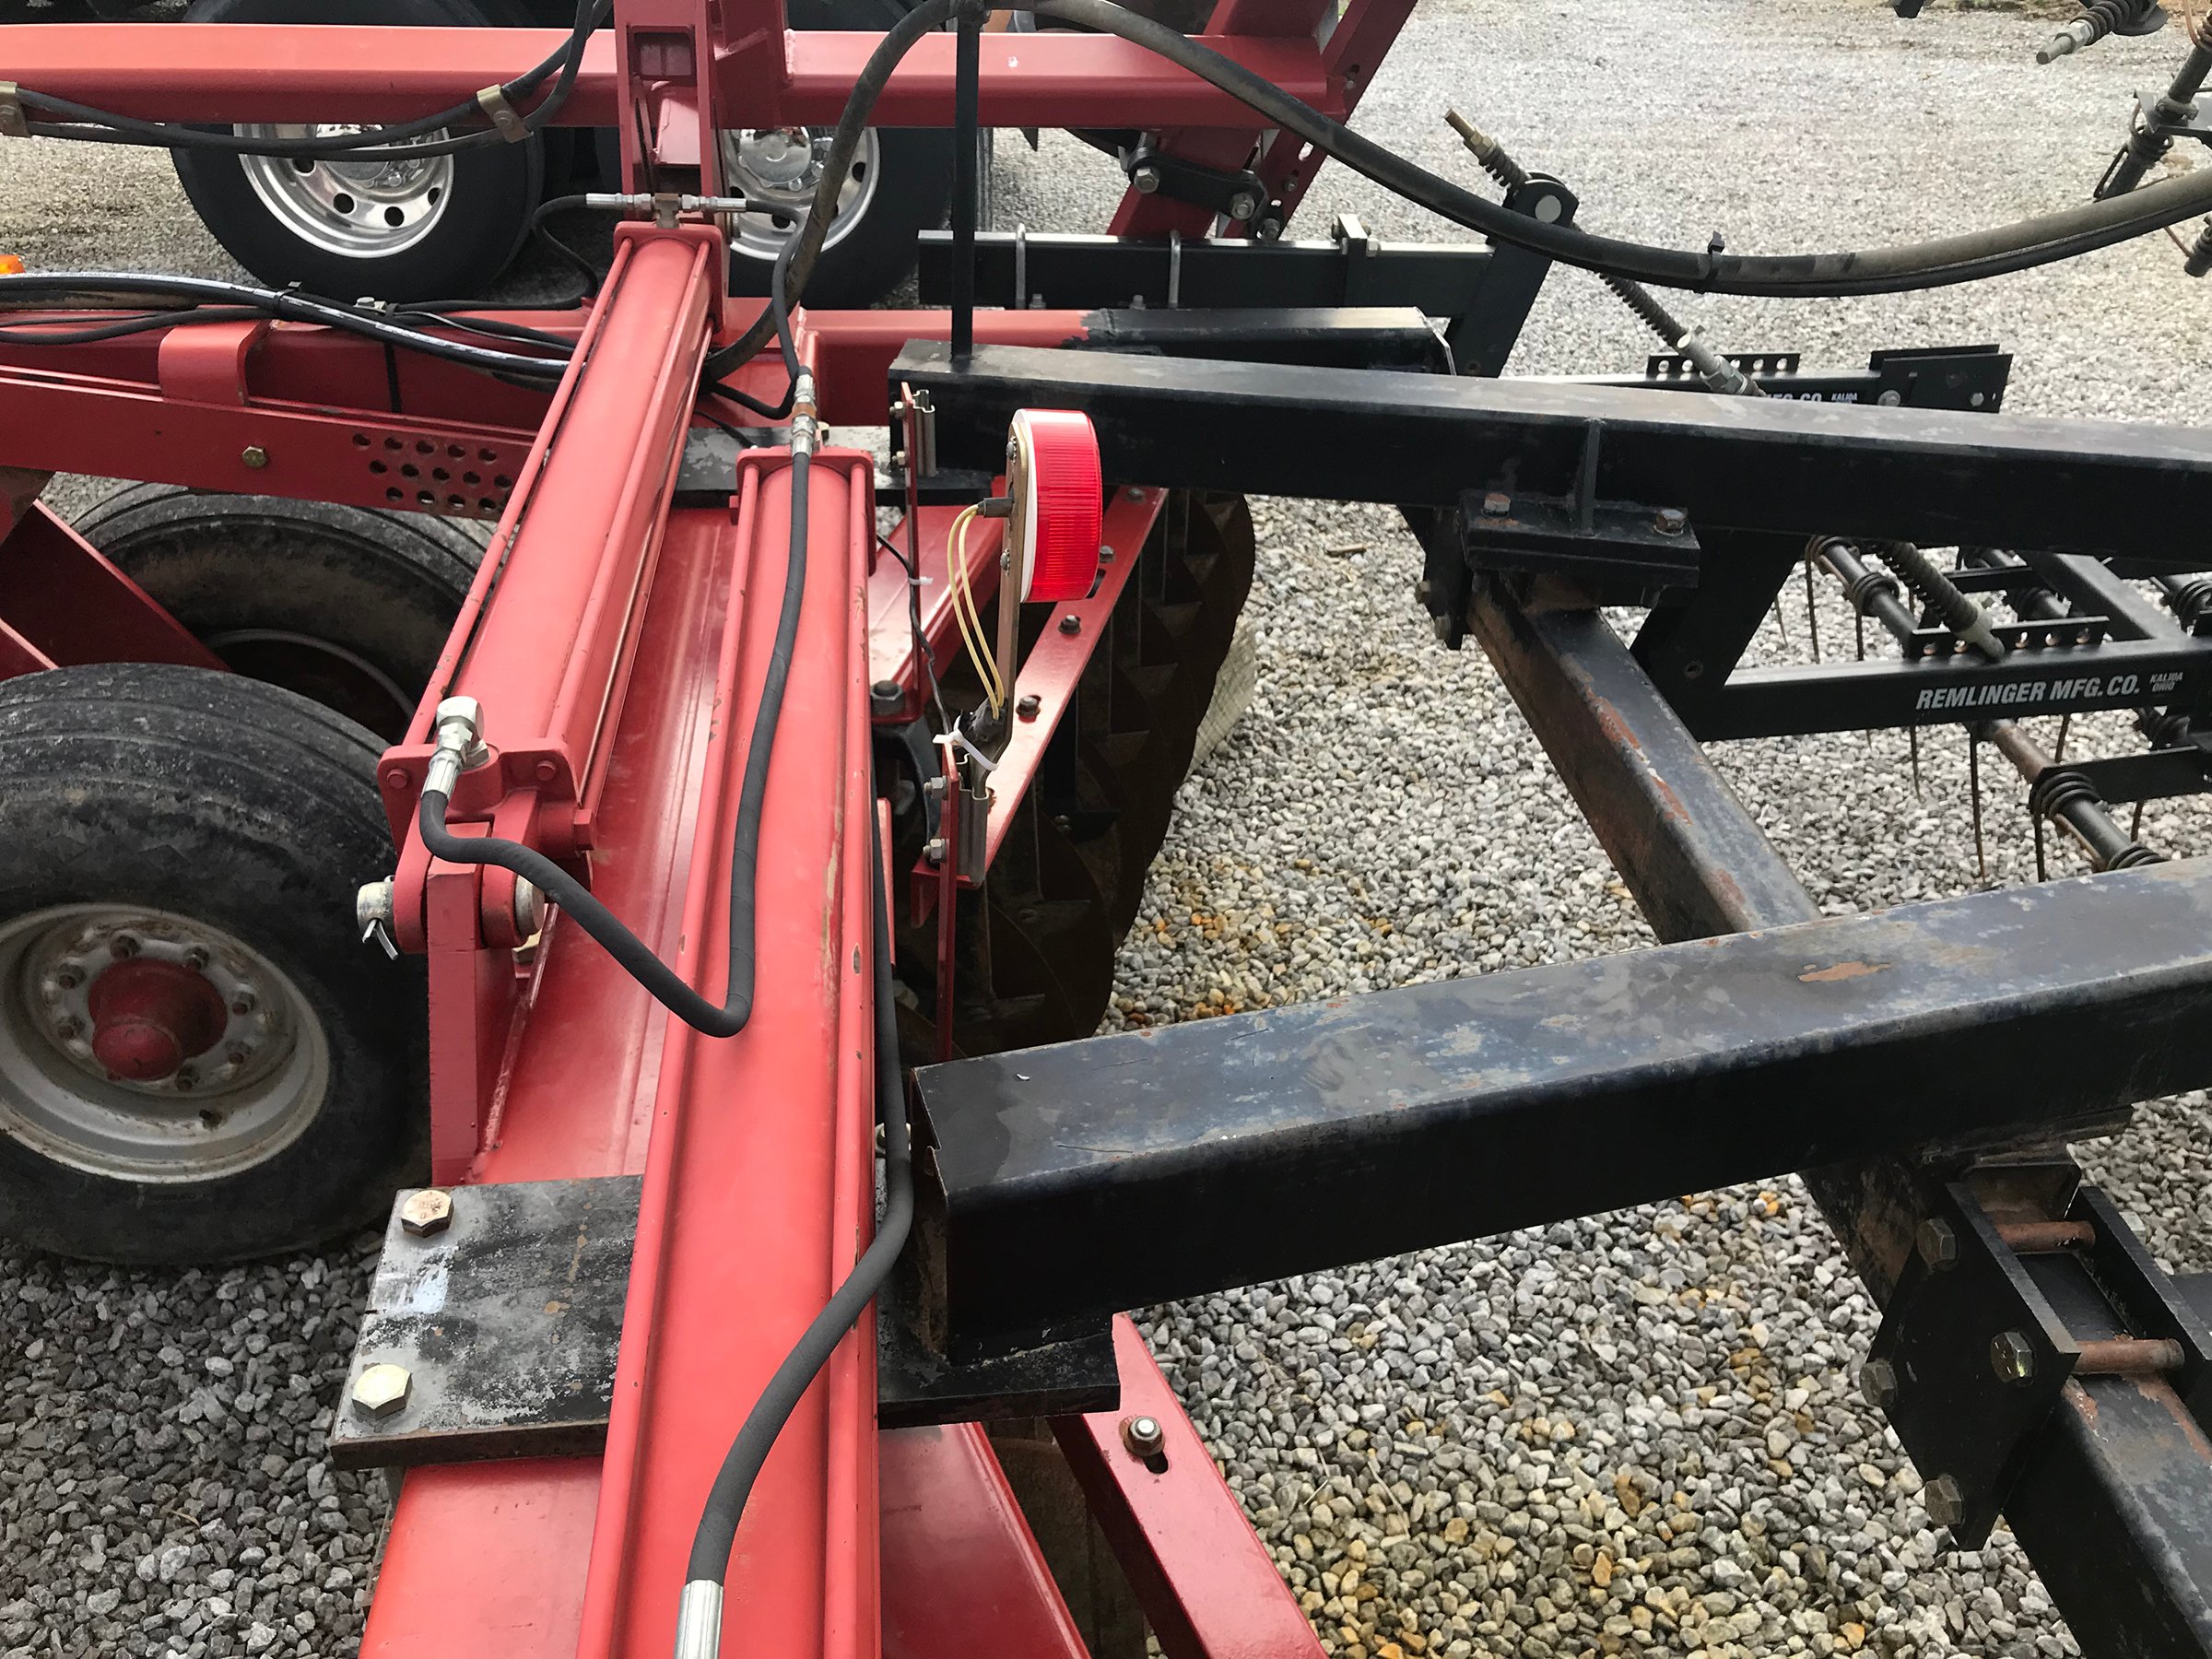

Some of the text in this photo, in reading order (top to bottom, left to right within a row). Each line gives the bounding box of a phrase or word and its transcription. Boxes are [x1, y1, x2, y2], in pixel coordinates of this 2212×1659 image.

[1915, 674, 2140, 710] REMLINGER MFG. CO.
